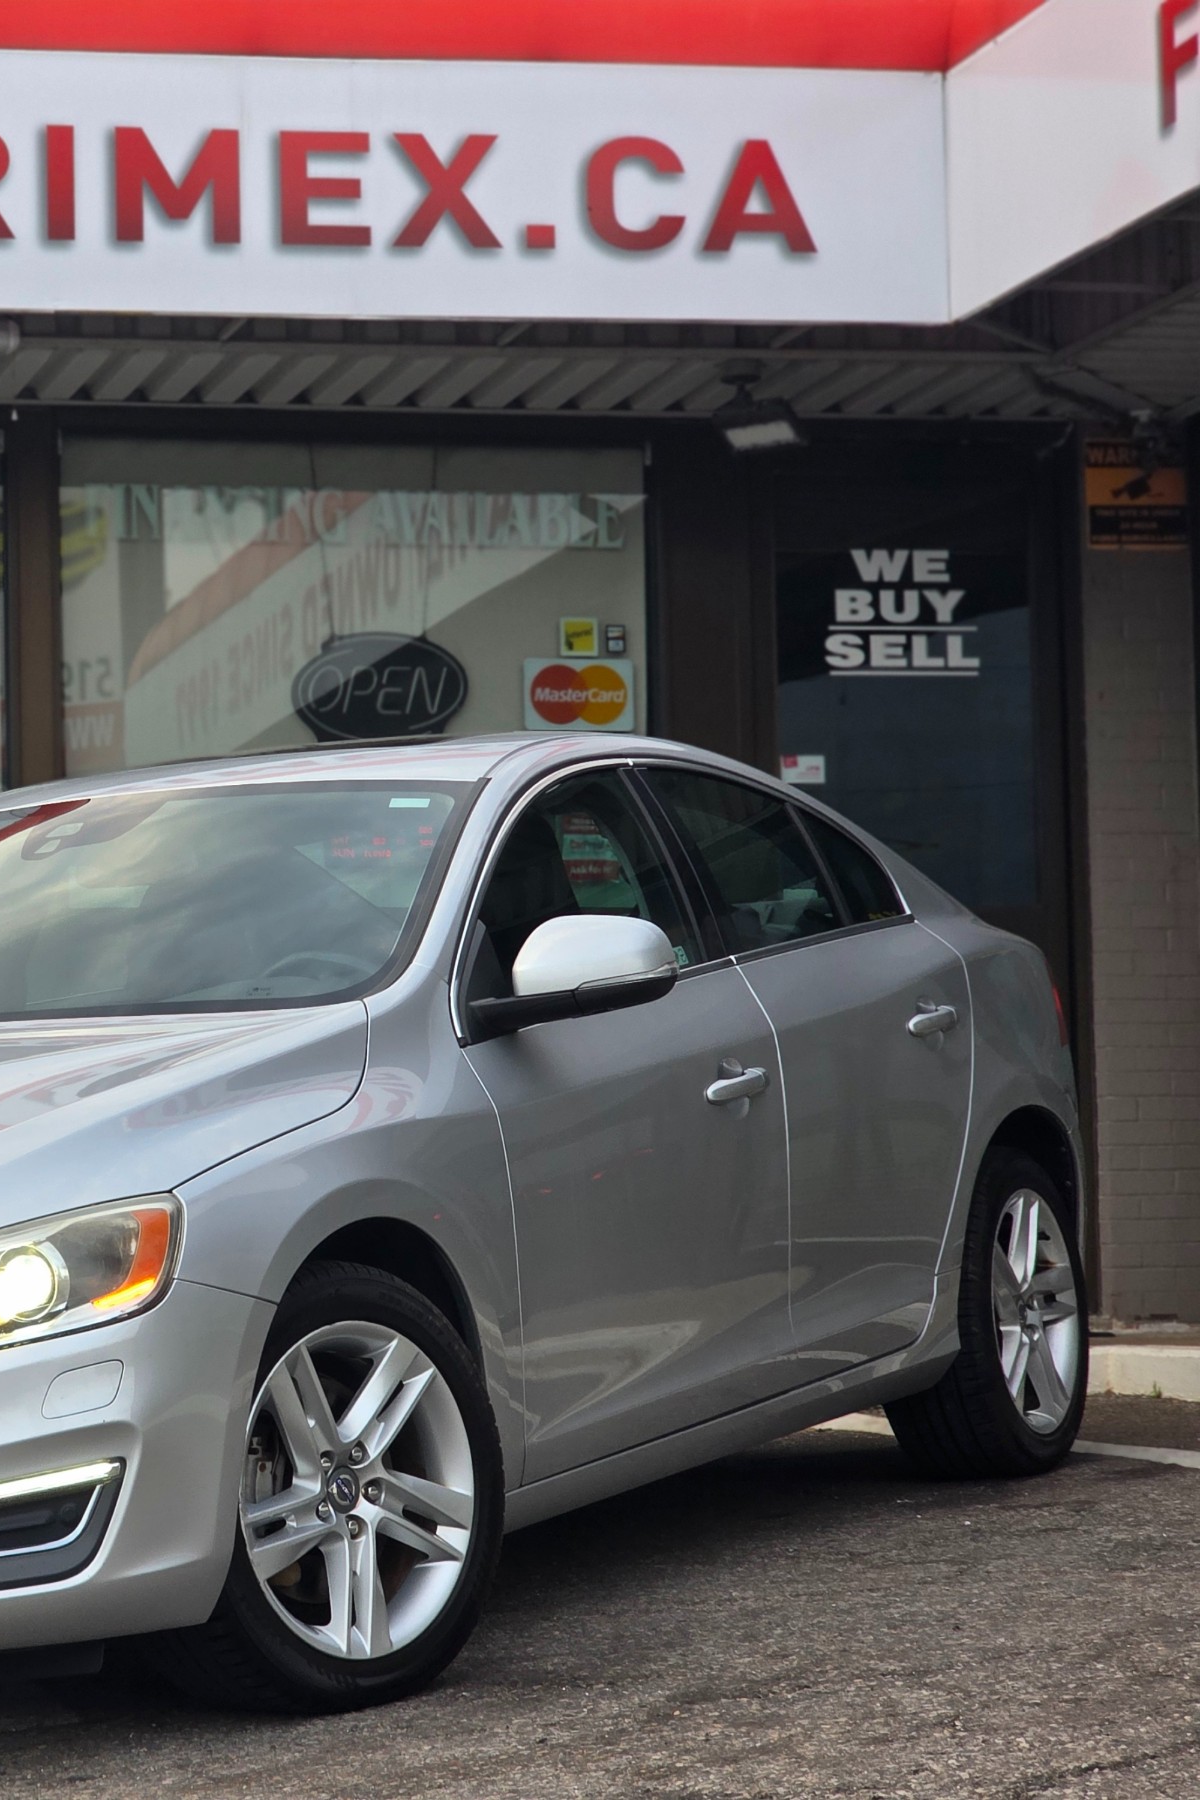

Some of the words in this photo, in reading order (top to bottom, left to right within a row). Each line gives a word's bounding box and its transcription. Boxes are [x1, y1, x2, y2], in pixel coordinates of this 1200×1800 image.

[851, 550, 951, 582] WE
[834, 589, 966, 623] BUY
[824, 633, 981, 668] SELL
[308, 665, 447, 715] OPEN
[534, 687, 625, 703] MasterCard
